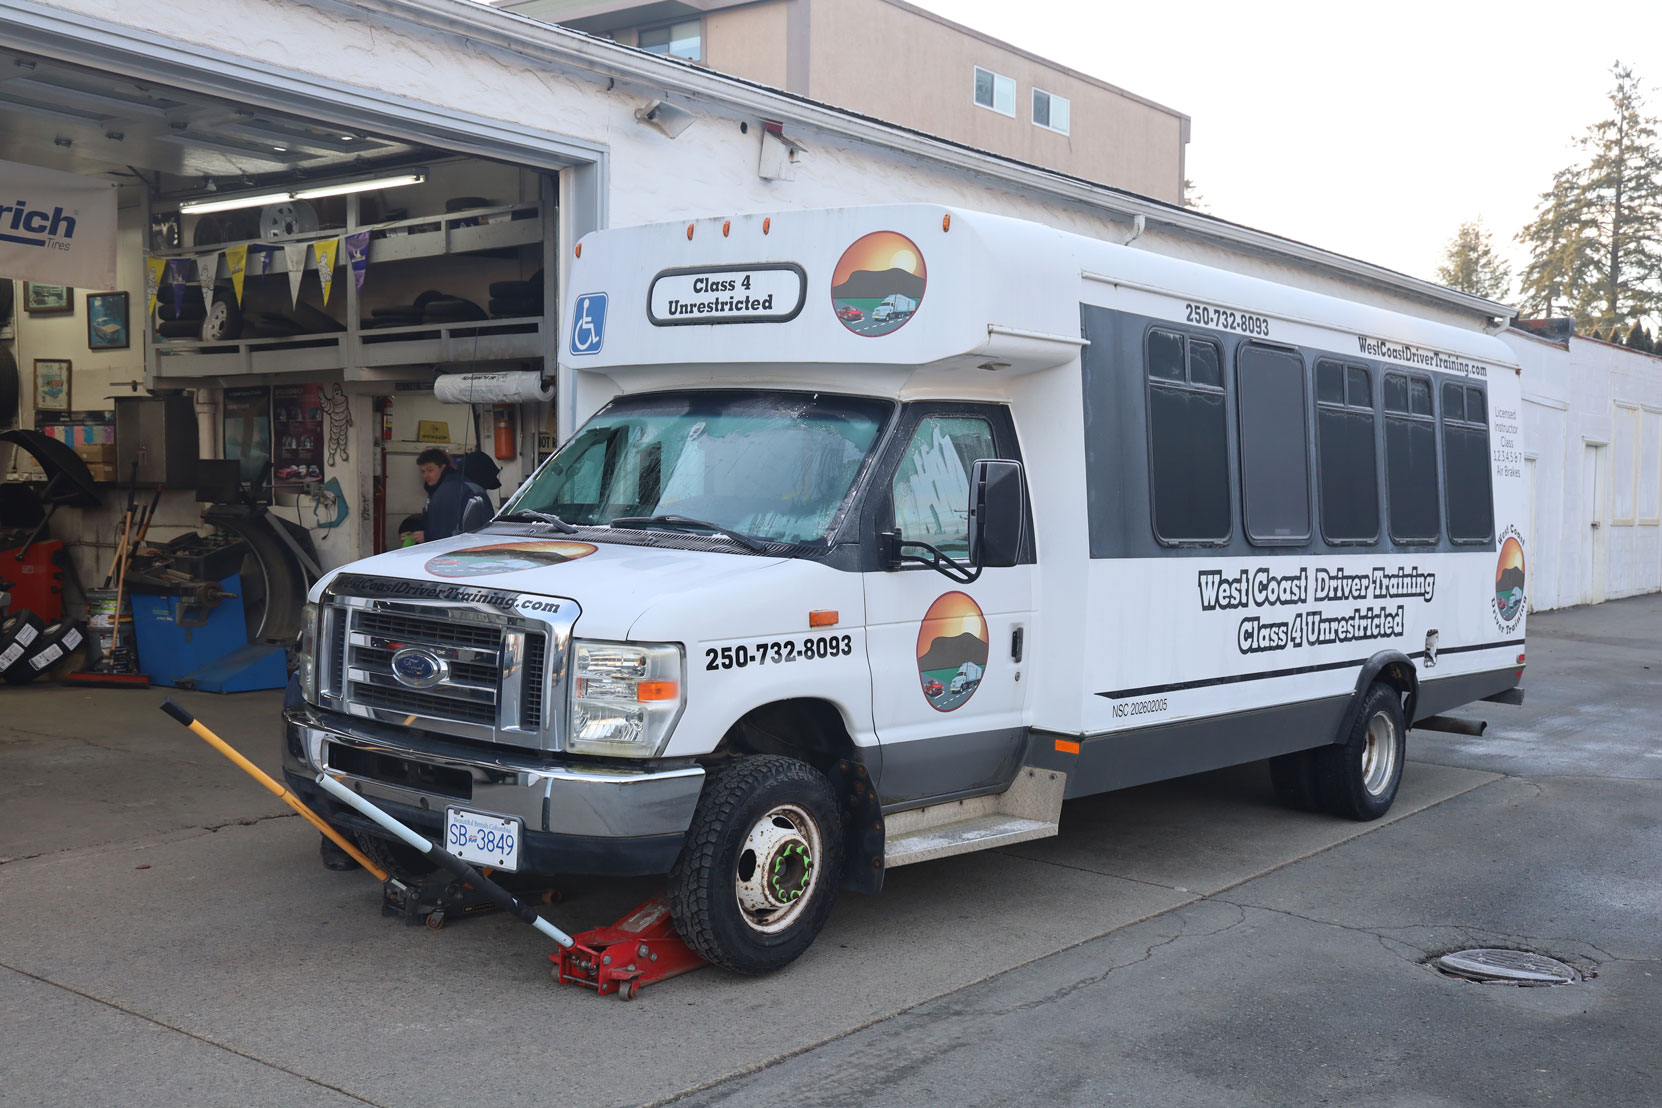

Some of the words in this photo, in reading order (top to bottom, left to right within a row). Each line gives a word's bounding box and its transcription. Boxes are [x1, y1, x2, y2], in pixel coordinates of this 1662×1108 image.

[46, 237, 71, 251] Tires
[693, 276, 736, 294] Class
[741, 274, 751, 291] 4
[668, 294, 773, 316] Unrestricted
[1186, 303, 1269, 337] 250-732-8093
[1358, 336, 1487, 377] WestCoastDriverTraining.com
[1495, 406, 1517, 421] Licensed
[1494, 421, 1519, 435] Instructor
[1500, 436, 1514, 449] Class
[1504, 466, 1521, 478] Brakes
[1497, 525, 1509, 546] West
[1510, 524, 1525, 546] Coast
[335, 575, 561, 615] WestCoastDriverTraining.com
[1198, 569, 1249, 610] West
[1252, 567, 1307, 607] Coast
[1314, 567, 1370, 602] Driver
[1372, 566, 1435, 603] Training
[1491, 596, 1505, 633] Driver
[1506, 595, 1527, 635] Training
[1238, 615, 1289, 655] Class
[1290, 613, 1304, 648] 4
[1306, 605, 1405, 646] Unrestricted
[705, 634, 852, 672] 250-732-8093
[1112, 703, 1129, 718] NSC
[1130, 698, 1168, 716] 202602005
[453, 816, 474, 827] Beautiful
[474, 820, 489, 830] British
[489, 823, 512, 834] Columbia
[449, 823, 468, 847] SB
[476, 828, 515, 856] 3849
